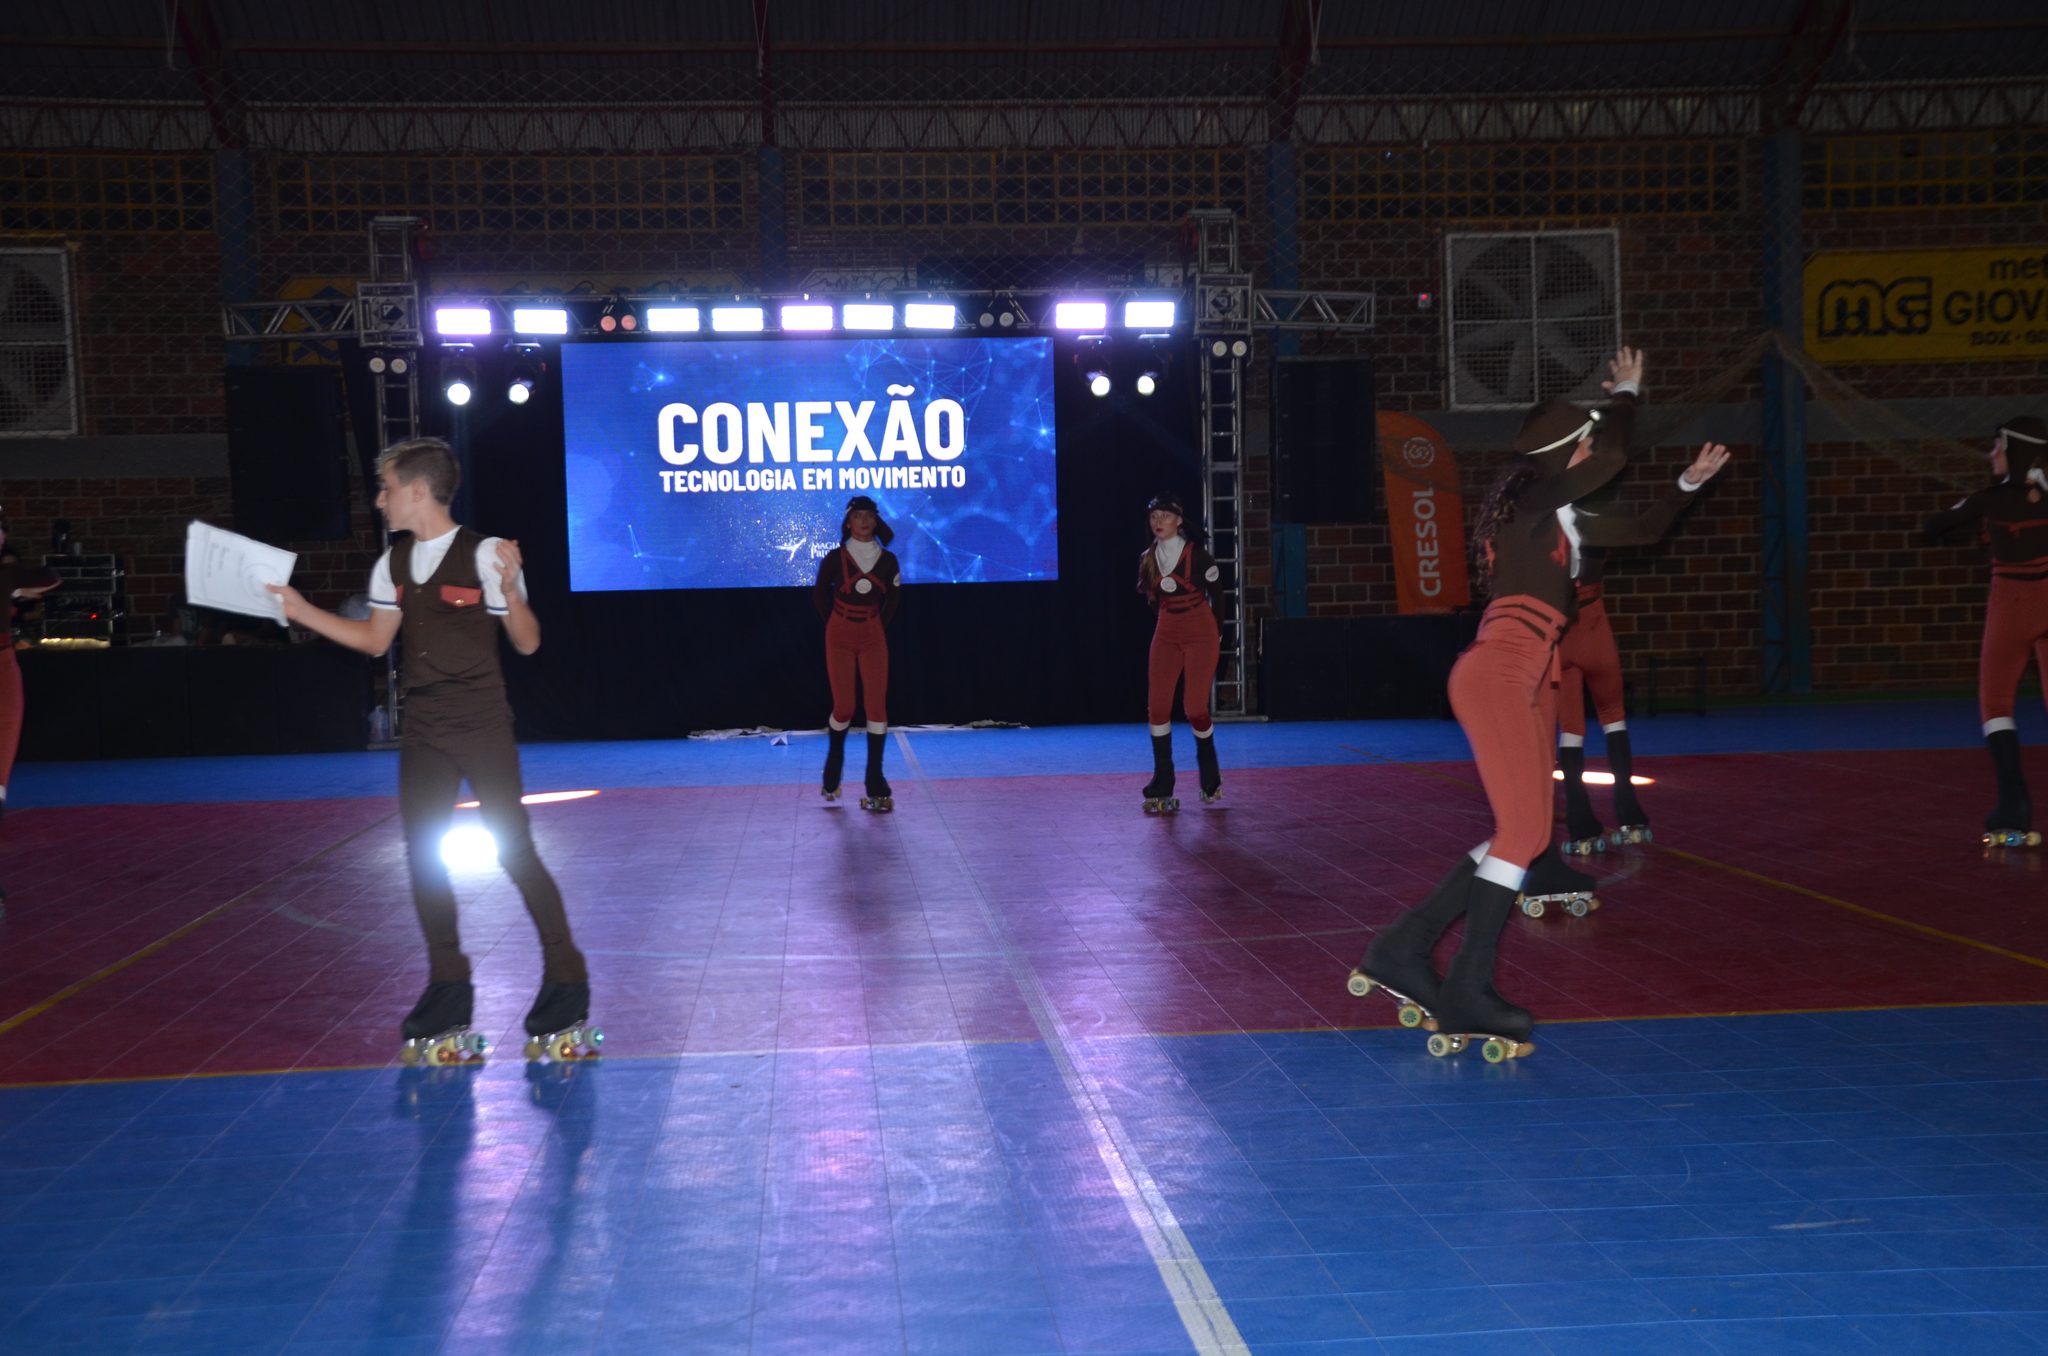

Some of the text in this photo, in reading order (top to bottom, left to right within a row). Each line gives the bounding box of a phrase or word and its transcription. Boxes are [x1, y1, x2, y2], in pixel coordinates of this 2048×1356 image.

[1944, 288, 2048, 325] GIOV
[657, 384, 966, 466] CONEXÃO
[659, 466, 967, 493] TECNOLOGIA EM MOVIMENTO
[1412, 483, 1442, 597] CRESOL
